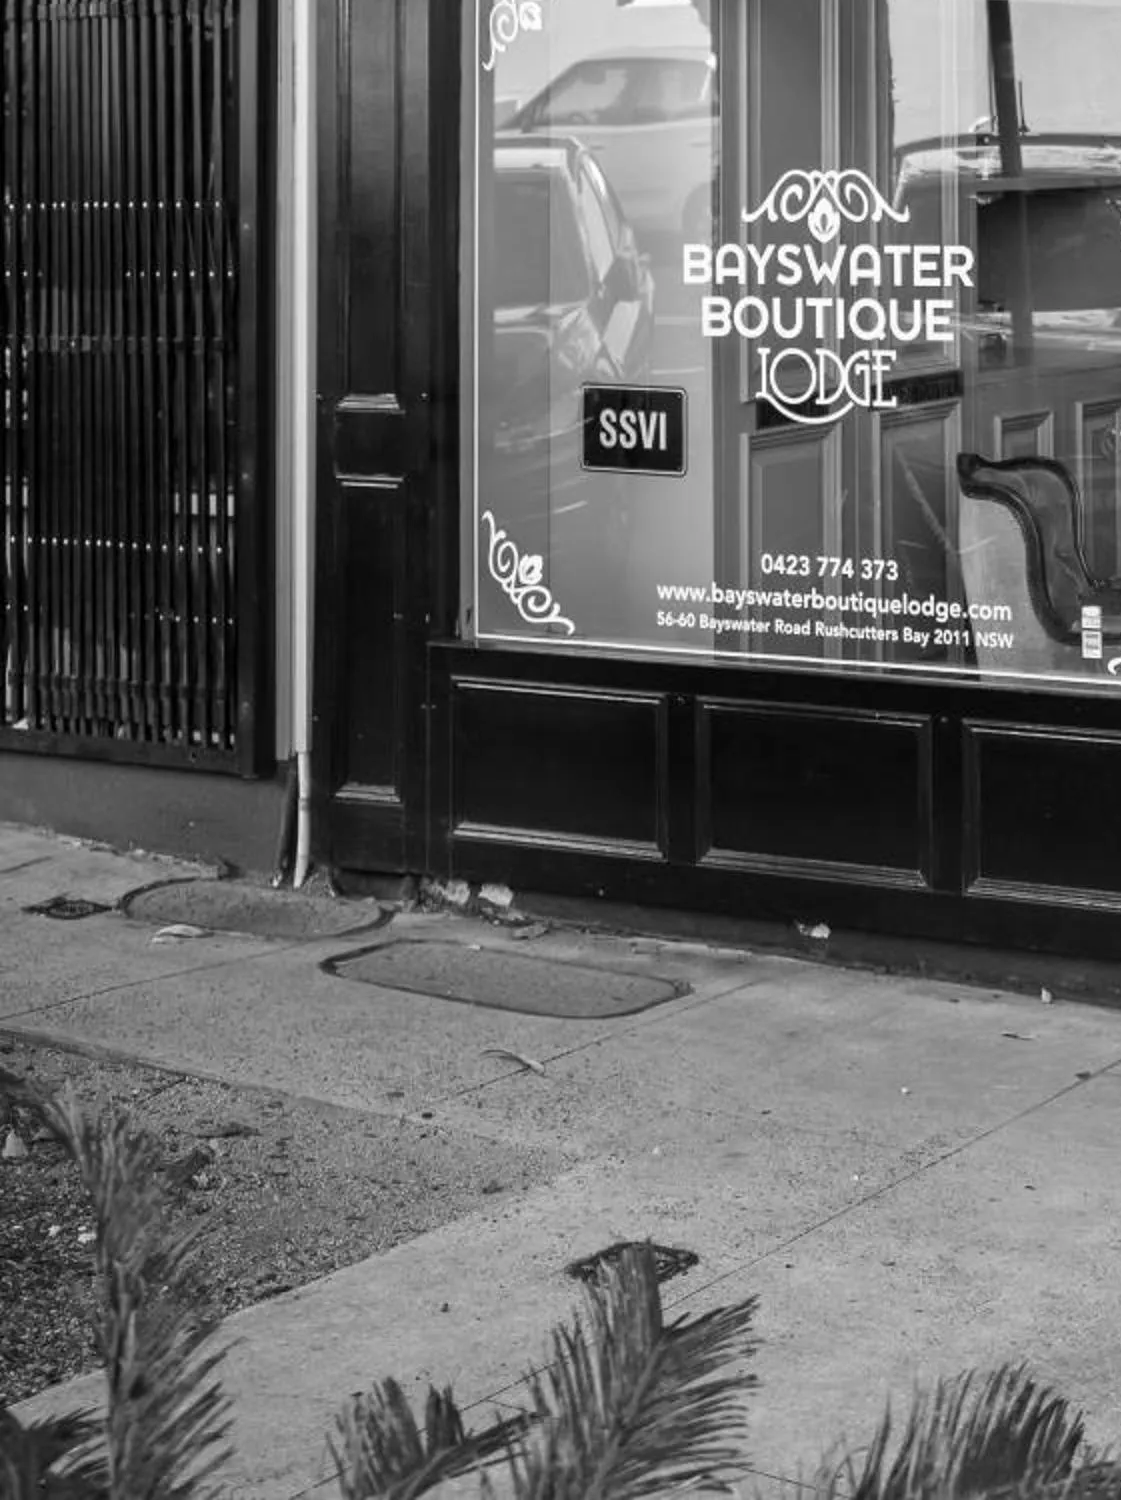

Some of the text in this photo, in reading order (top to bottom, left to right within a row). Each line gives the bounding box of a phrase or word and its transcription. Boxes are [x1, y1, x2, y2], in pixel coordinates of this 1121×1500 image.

[682, 243, 976, 287] BAYSWATER
[701, 296, 955, 341] BOUTIQUE
[755, 347, 897, 424] LODGE
[599, 408, 668, 451] SSVI
[760, 553, 899, 581] 0423 774 373
[656, 582, 1013, 624] www.bayswaterboutiquelodge.com
[656, 611, 1014, 649] 56-60 Bayswater Road Rushcutters Bay 2011 NSW
